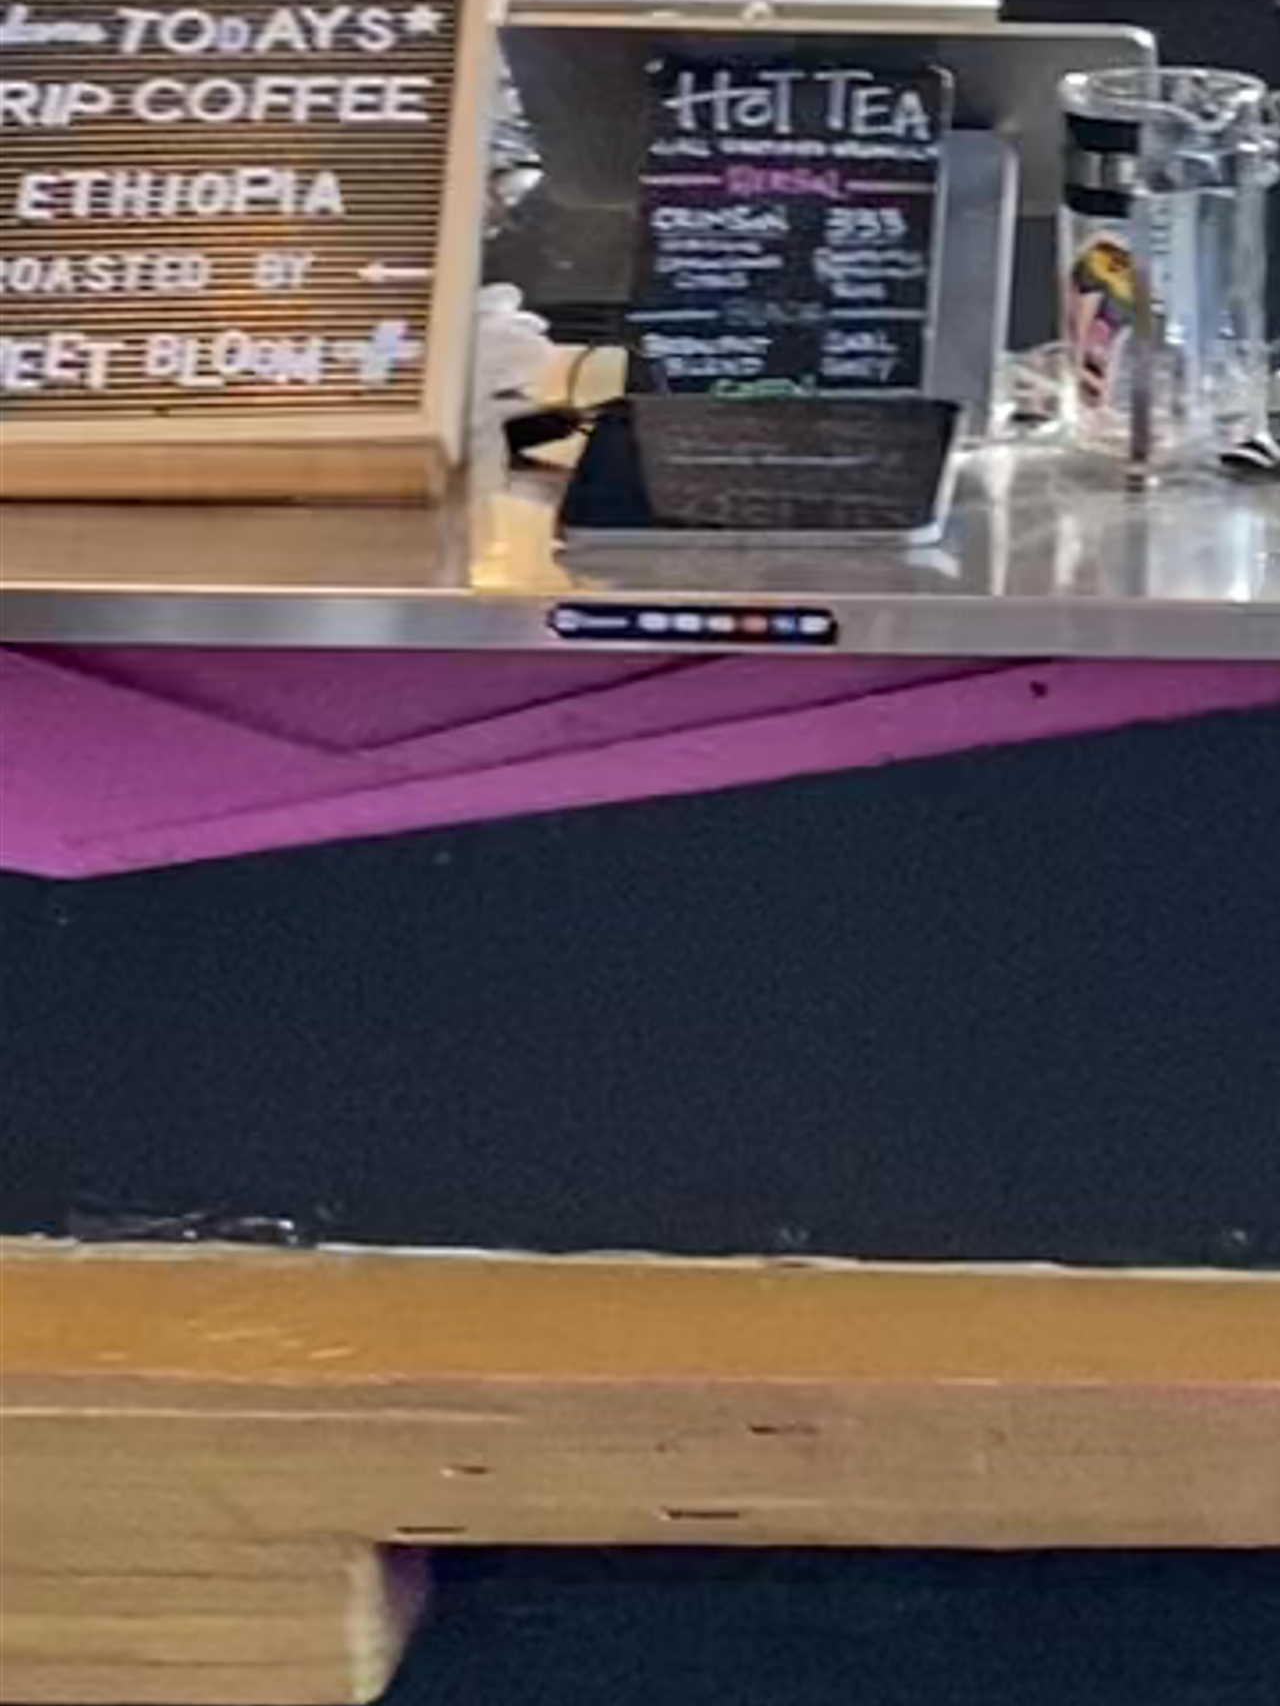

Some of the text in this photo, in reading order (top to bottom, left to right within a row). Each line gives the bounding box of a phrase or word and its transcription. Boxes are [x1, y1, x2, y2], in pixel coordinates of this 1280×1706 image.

[116, 7, 396, 54] TODAYS
[133, 77, 433, 123] COFFEE
[812, 71, 930, 141] TEA
[17, 167, 343, 220] ETHIOPIA
[0, 254, 209, 292] OASTED
